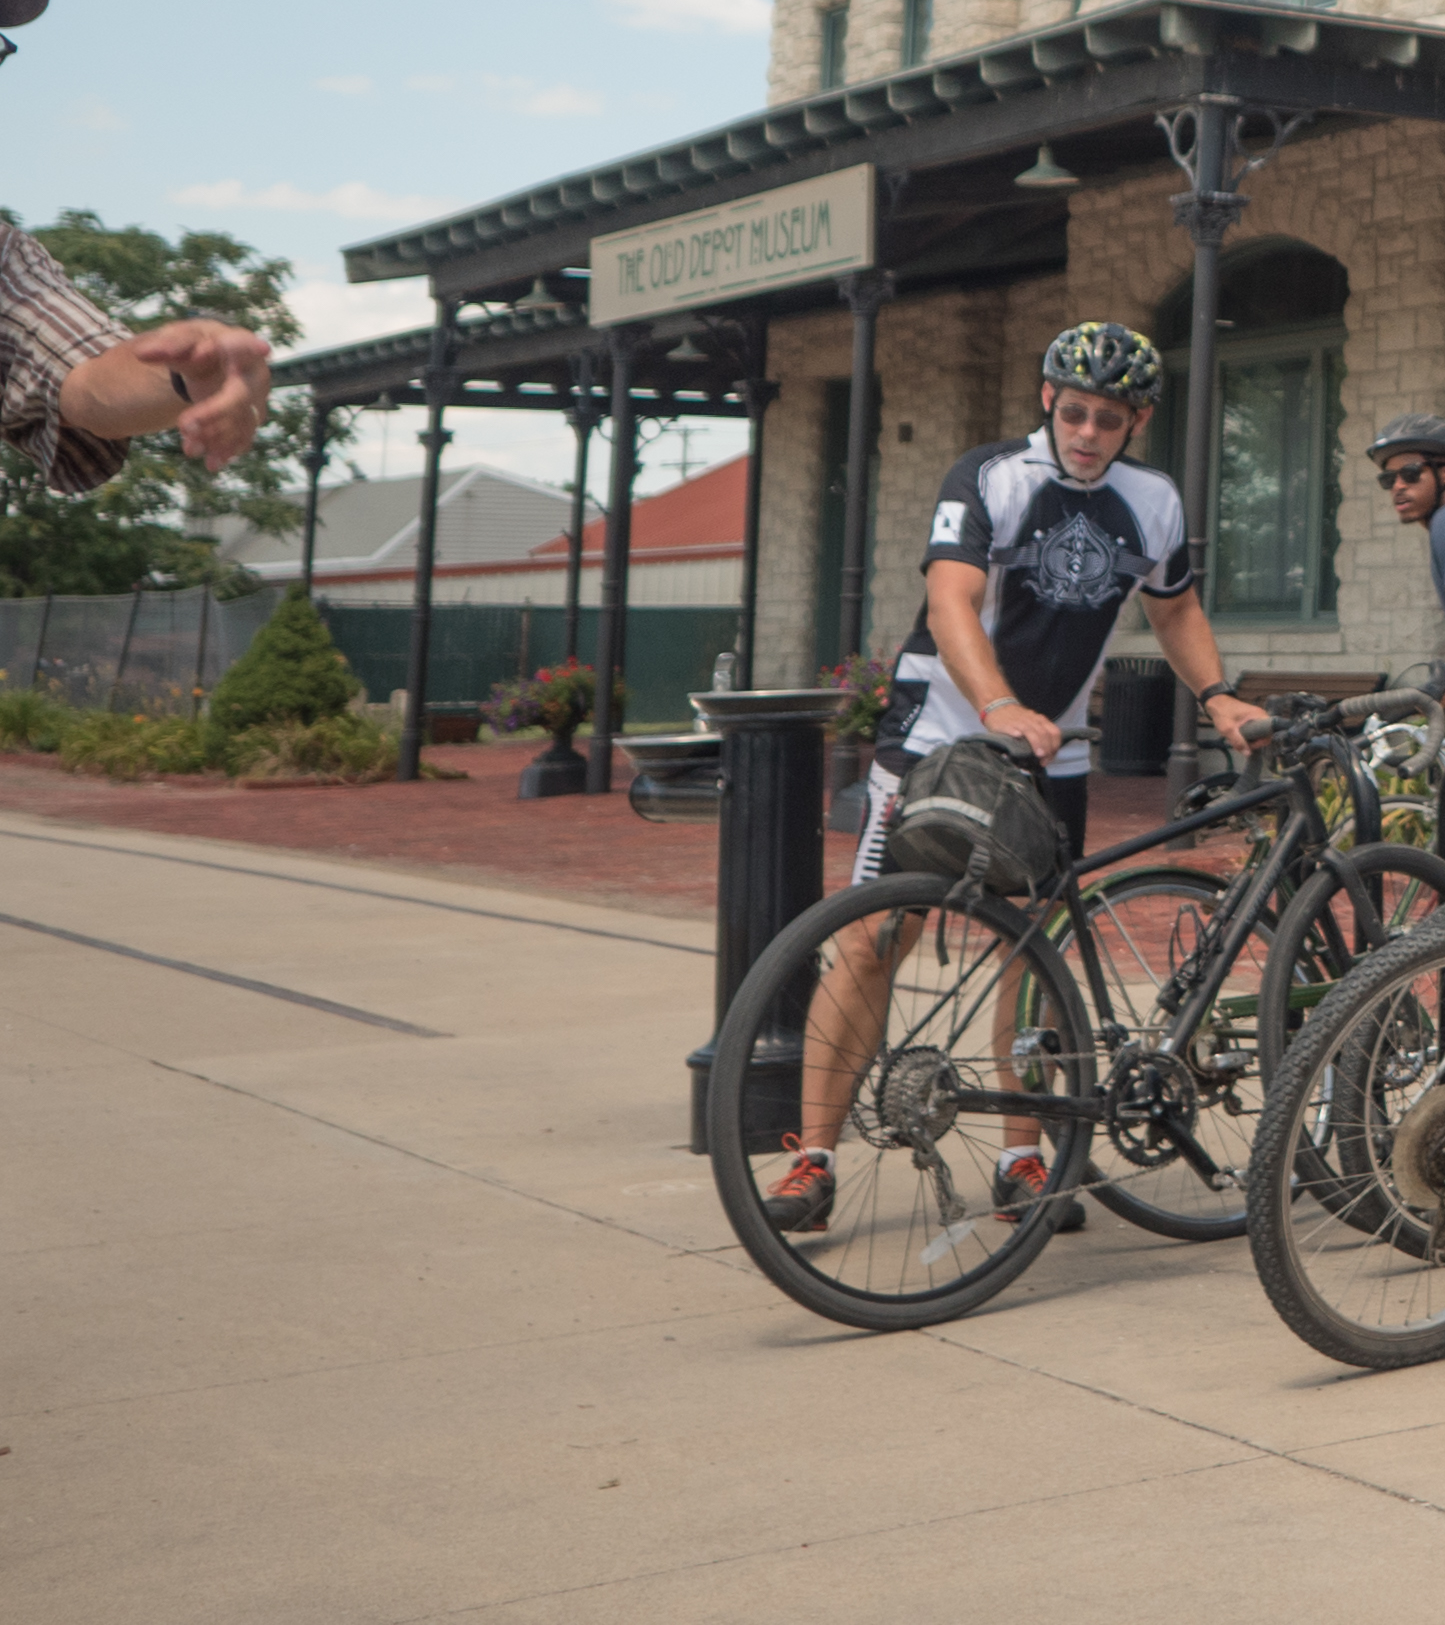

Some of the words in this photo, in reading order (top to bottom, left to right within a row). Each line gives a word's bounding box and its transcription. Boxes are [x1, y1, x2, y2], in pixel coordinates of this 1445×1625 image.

[617, 248, 645, 295] THE
[649, 239, 685, 289] OLD
[689, 222, 746, 279] DEPOT
[749, 198, 832, 266] MUSEUM
